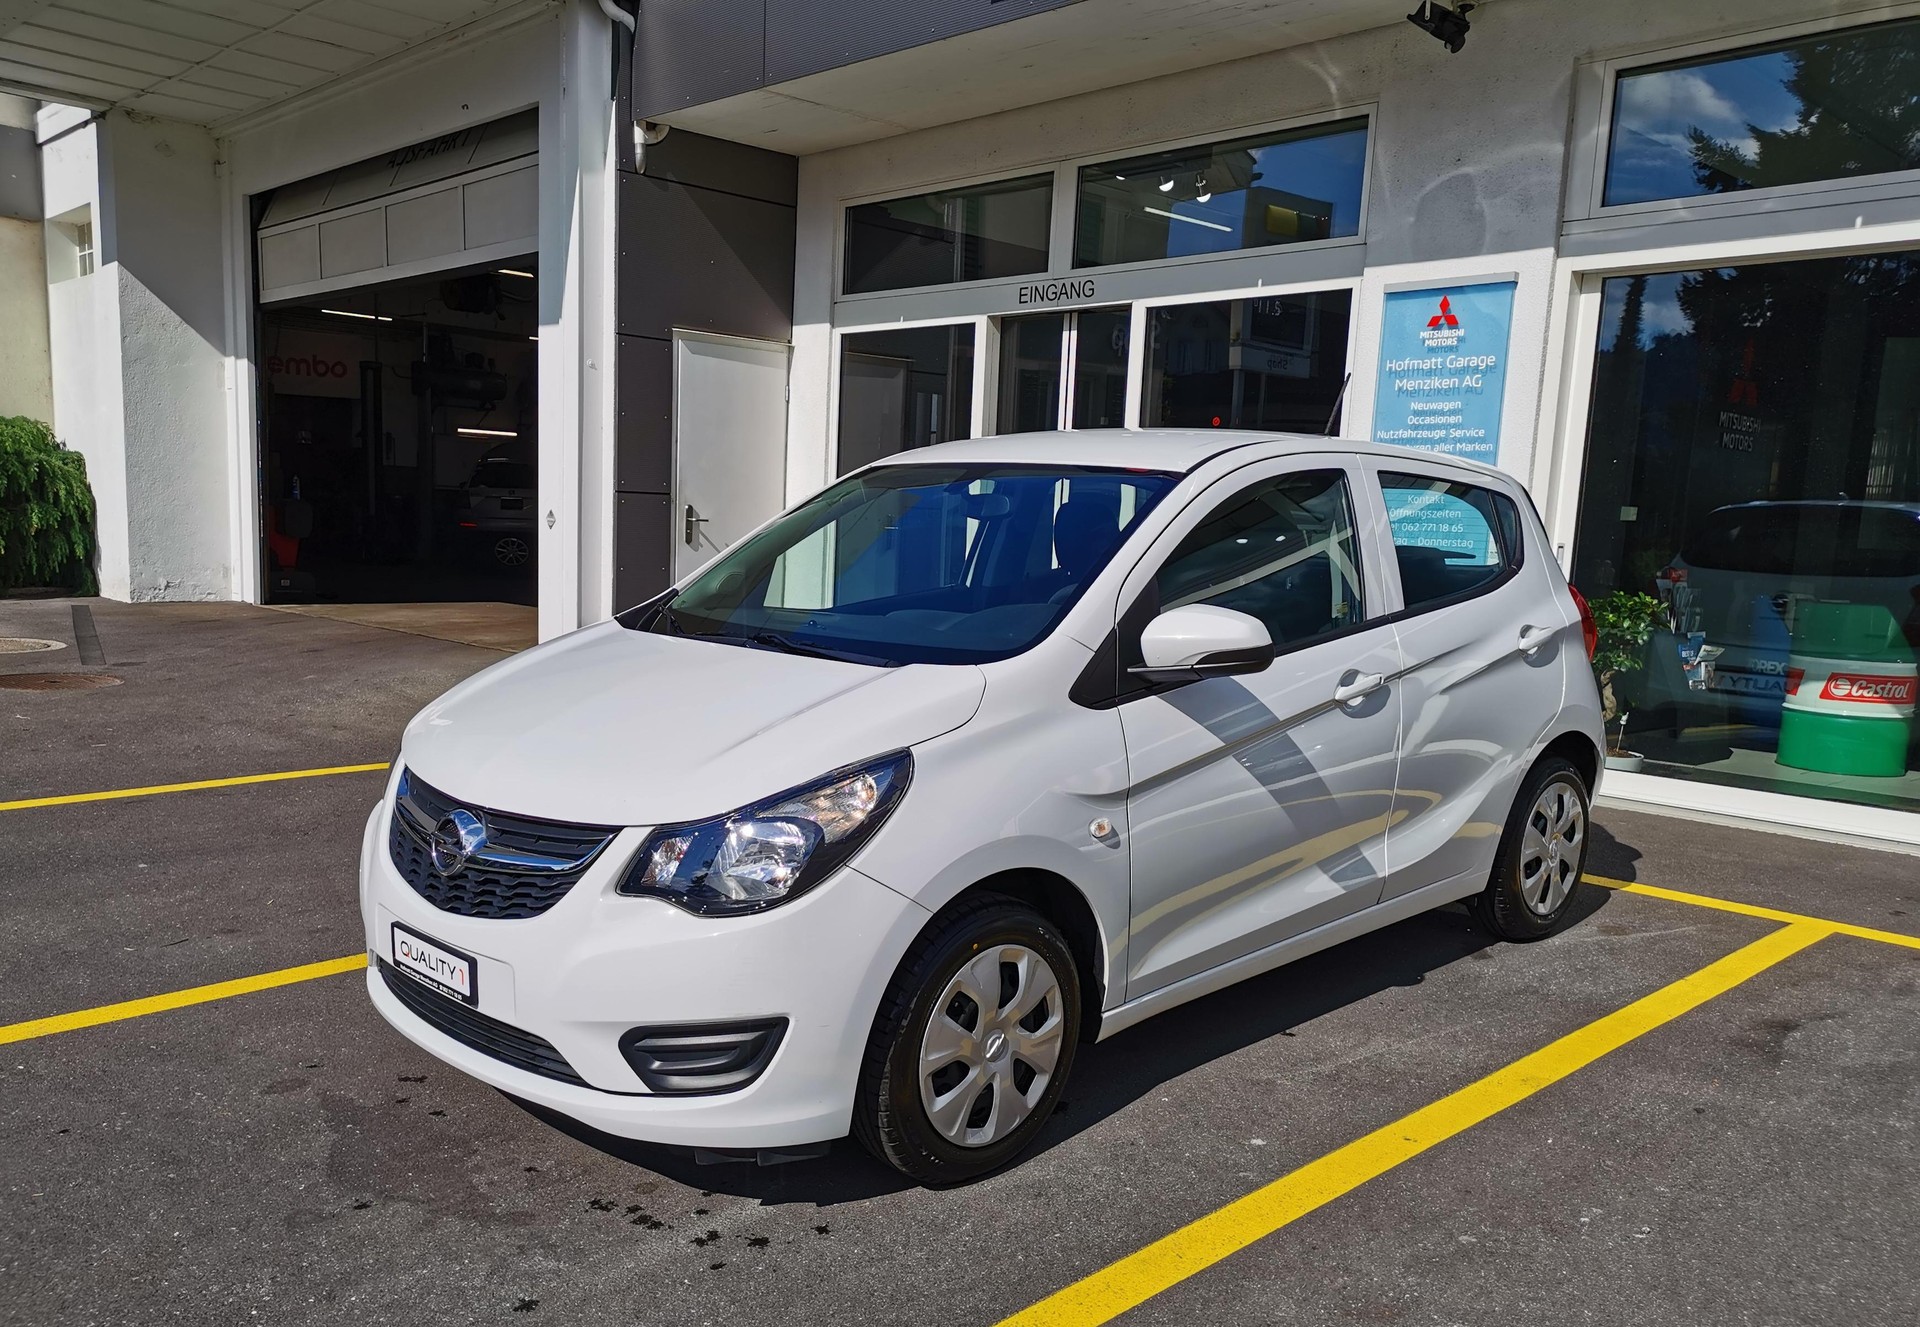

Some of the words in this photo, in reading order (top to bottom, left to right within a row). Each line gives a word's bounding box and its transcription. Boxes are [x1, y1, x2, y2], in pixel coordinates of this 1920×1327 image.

[1019, 280, 1095, 304] EINGANG
[1420, 329, 1465, 339] MITSUBISHI
[1424, 337, 1458, 347] MOTORS
[1386, 357, 1443, 372] Hofmatt
[1446, 355, 1496, 370] Garage
[1395, 376, 1459, 391] Menziken
[1462, 374, 1482, 388] AG
[1410, 401, 1462, 412] Neuwagen
[1407, 414, 1462, 425] Occasionen
[1719, 411, 1761, 433] MITSUBISHI
[1377, 428, 1447, 440] Nutzfahrzeuge
[1449, 427, 1485, 438] Service
[1433, 443, 1454, 452] aller
[1456, 441, 1493, 452] Marken
[1722, 432, 1754, 452] MOTORS
[1407, 494, 1445, 505] Kontakt
[1402, 523, 1420, 532] 062
[1422, 523, 1437, 532] 771
[1439, 523, 1449, 532] 18
[1451, 523, 1464, 533] 65
[1417, 536, 1474, 549] Donnerstag
[1850, 680, 1910, 698] Castrol
